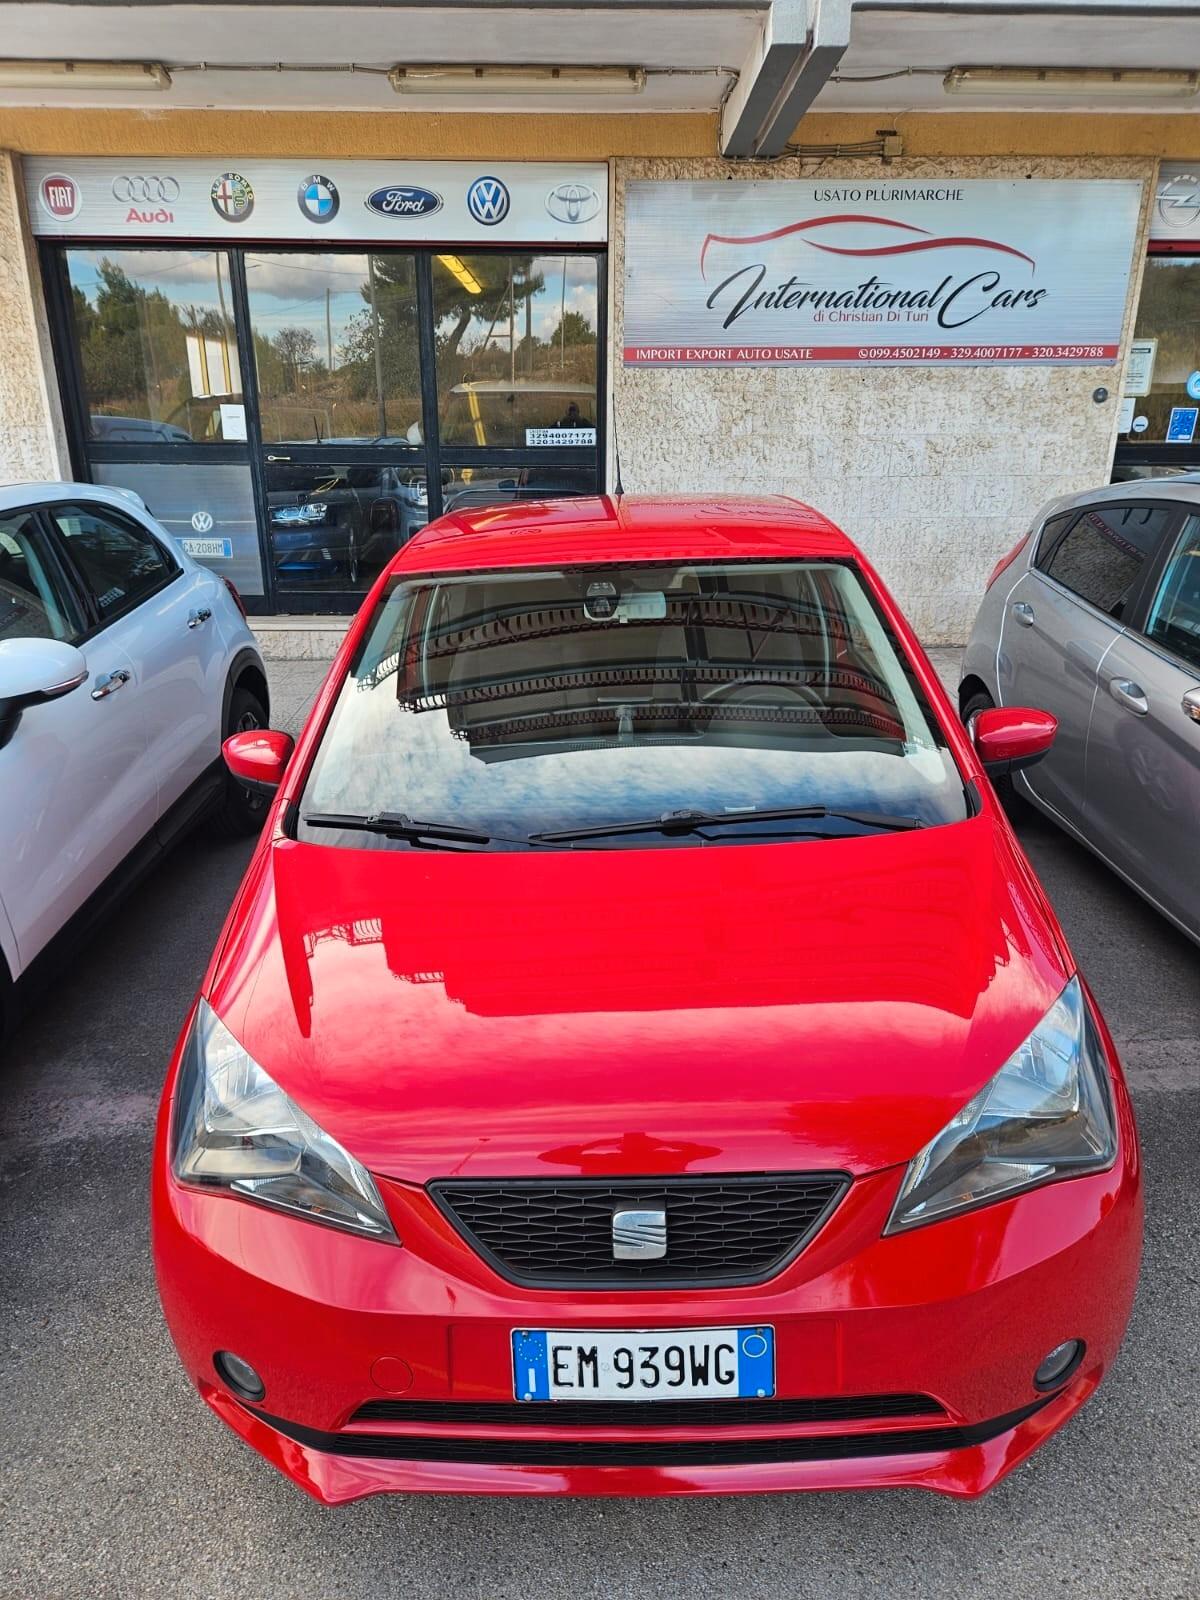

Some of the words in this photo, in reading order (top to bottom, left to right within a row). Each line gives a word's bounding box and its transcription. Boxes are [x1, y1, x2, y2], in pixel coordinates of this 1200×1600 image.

[229, 173, 254, 200] ROMEO
[301, 175, 336, 191] BMW
[48, 186, 73, 208] FIAT
[382, 190, 425, 213] Ford
[814, 189, 861, 201] USATO
[865, 189, 965, 201] PLURIMARCHE
[126, 208, 174, 223] Audi
[706, 263, 951, 330] International
[937, 271, 1048, 329] Cars
[813, 310, 825, 322] di
[828, 310, 883, 322] Christian
[887, 310, 901, 322] Di
[905, 310, 929, 322] Turi
[636, 349, 683, 360] IMPORT
[686, 349, 732, 360] EXPORT
[736, 349, 772, 360] AUTO
[775, 349, 813, 360] USATE
[869, 347, 941, 359] 099.4502149
[950, 347, 1022, 359] 329.4007177
[1031, 346, 1104, 358] 320.3429788
[552, 1345, 599, 1388] EM
[613, 1344, 735, 1389] 939WG
